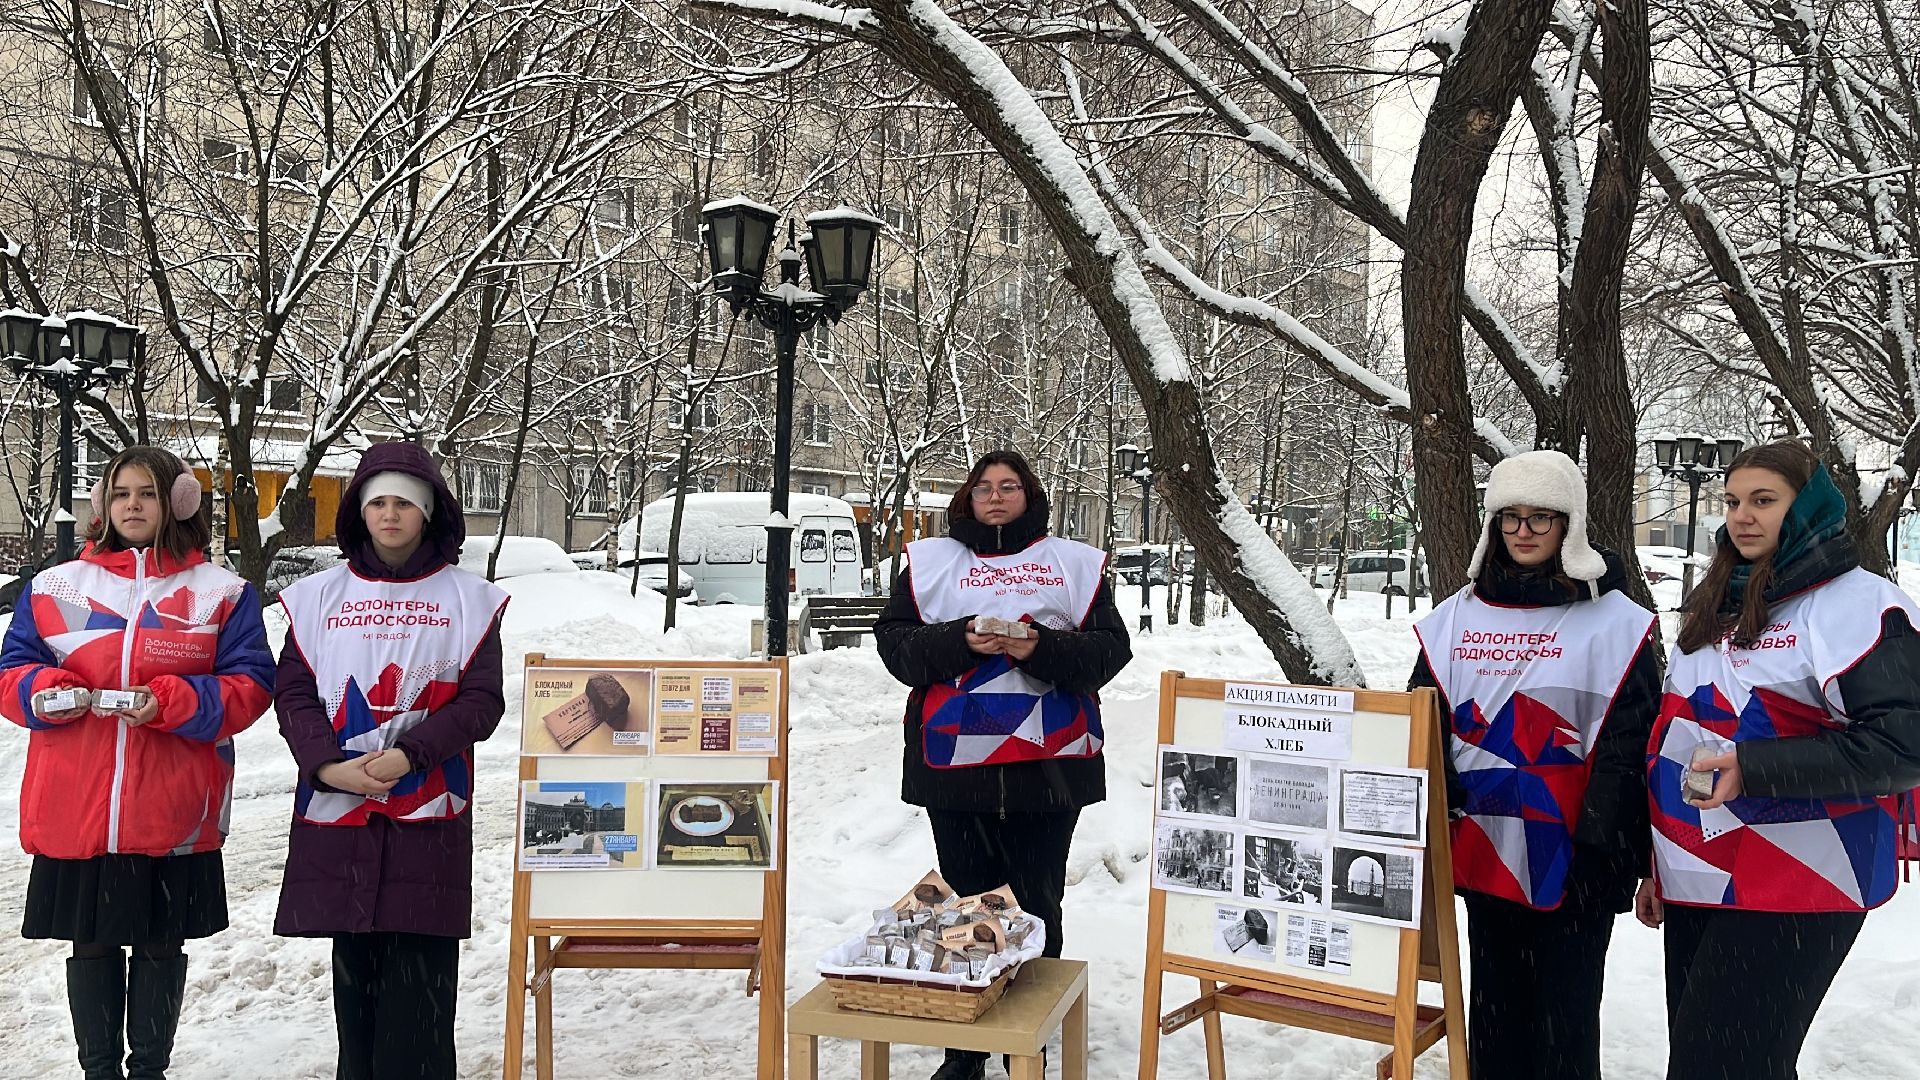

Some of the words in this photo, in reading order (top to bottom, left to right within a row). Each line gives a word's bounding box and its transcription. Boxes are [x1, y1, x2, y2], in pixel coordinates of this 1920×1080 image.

[144, 638, 203, 651] ВОЛОНТЕРЫ
[1452, 645, 1563, 662] ПОДМОСКОЬЯ
[534, 680, 573, 690] БЛОКАДНЫЙ
[534, 690, 551, 698] ХЛЕБ
[1226, 687, 1273, 703] АКЦИЯ
[1277, 691, 1338, 707] ПАМЯТИ
[1238, 714, 1332, 733] БЛОКАДНЫЙ
[1265, 738, 1304, 752] ХЛЕБ
[1254, 784, 1324, 804] ЛЕНИНГРАДА
